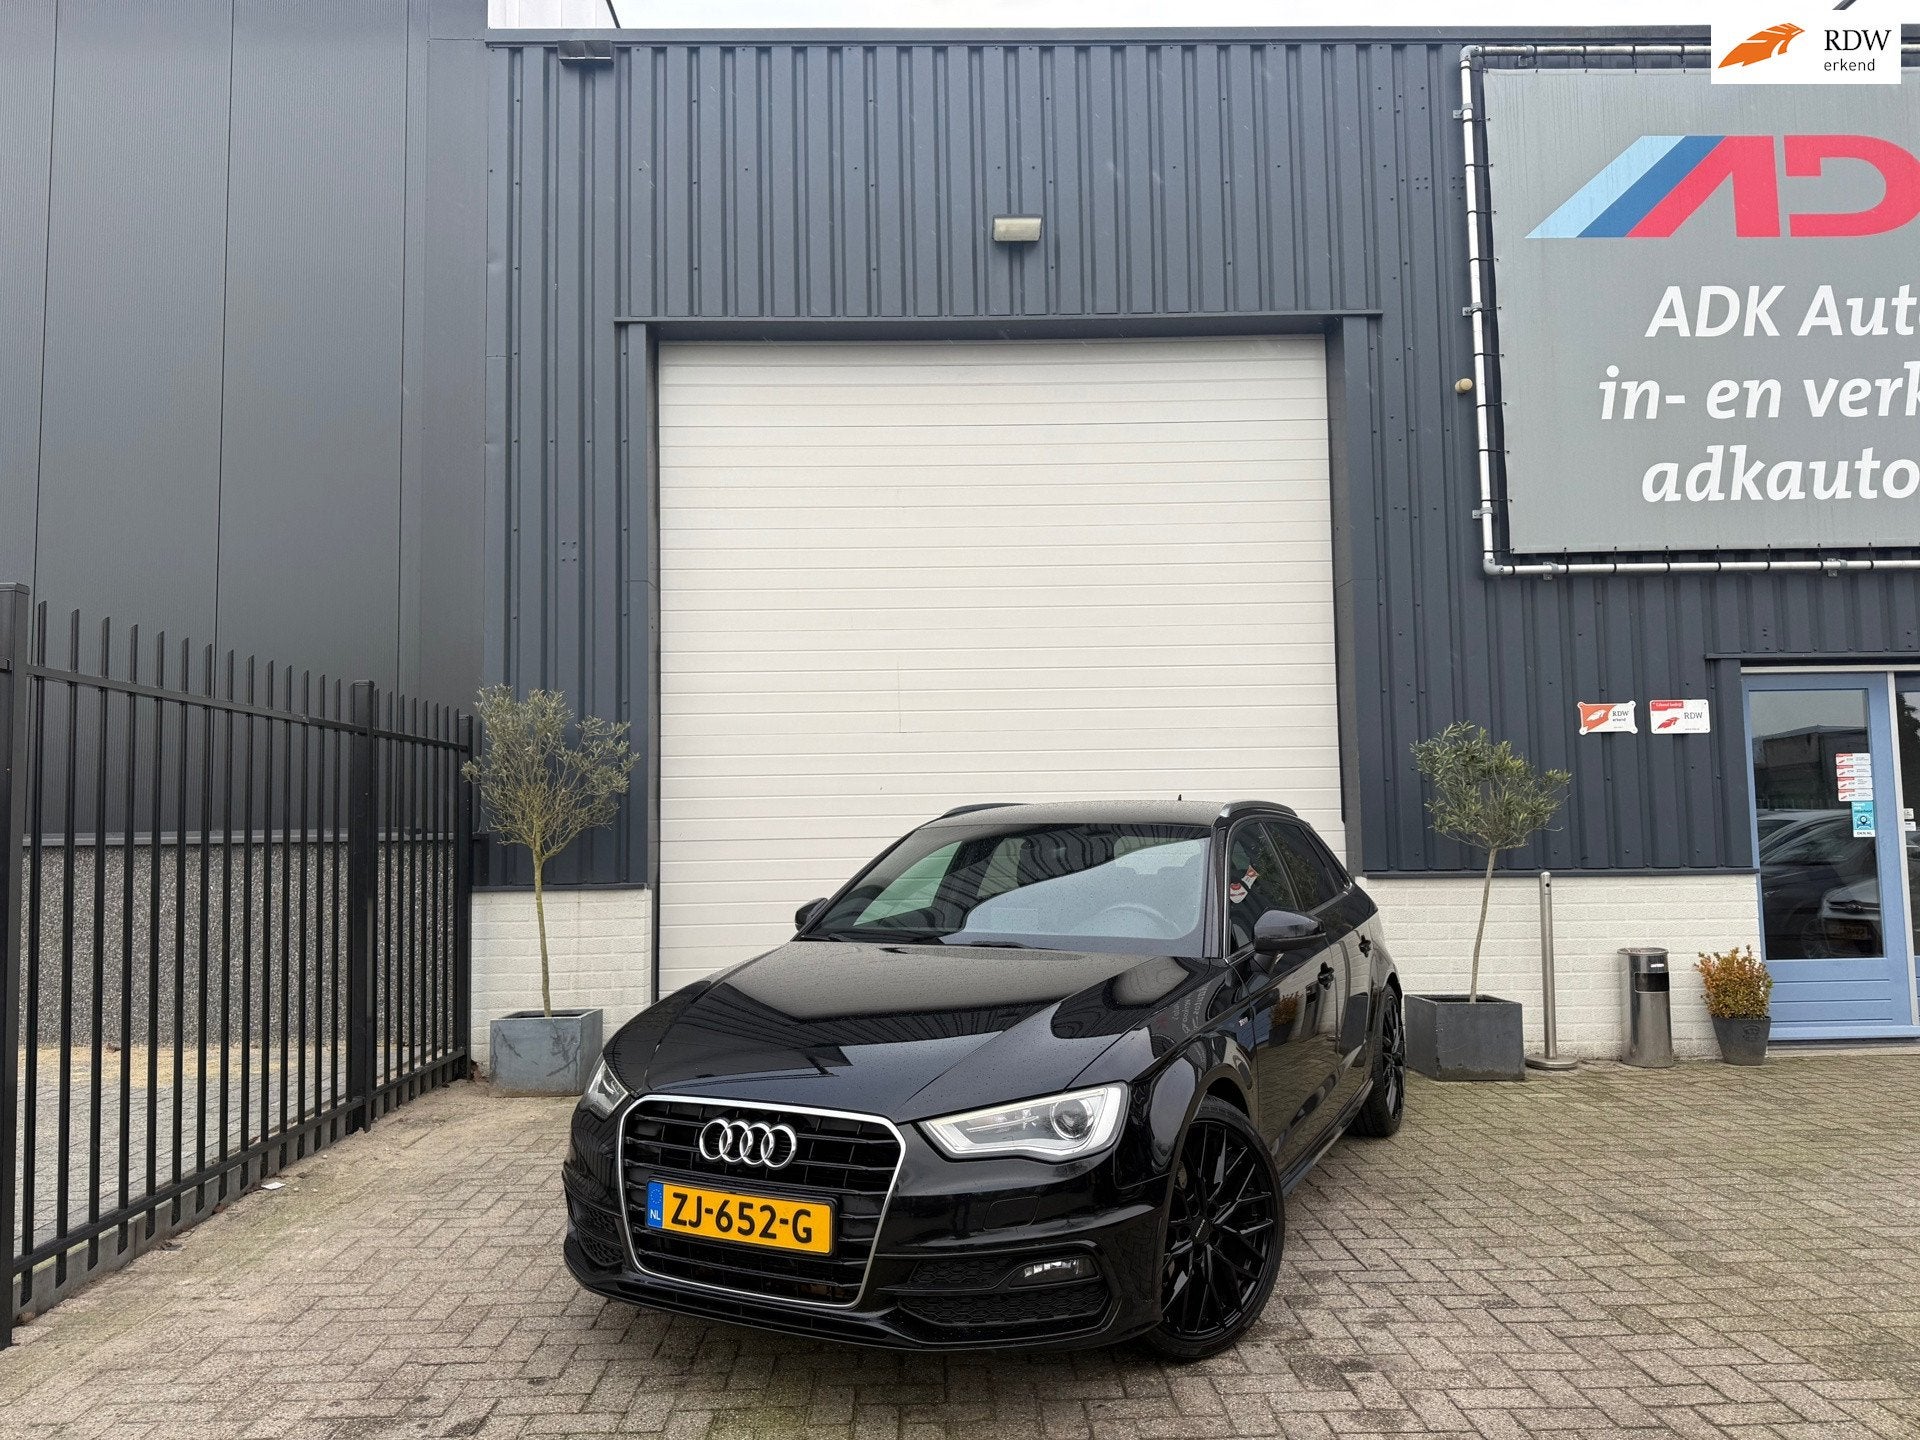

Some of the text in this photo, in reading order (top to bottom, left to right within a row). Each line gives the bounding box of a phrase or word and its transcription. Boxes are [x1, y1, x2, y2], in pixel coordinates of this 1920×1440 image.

[1644, 283, 1920, 337] ADK Aut
[1598, 364, 1686, 420] in-
[1706, 378, 1782, 419] en
[1641, 444, 1920, 503] adkauto
[650, 1209, 662, 1221] NL
[671, 1191, 812, 1244] ZJ-652-G
